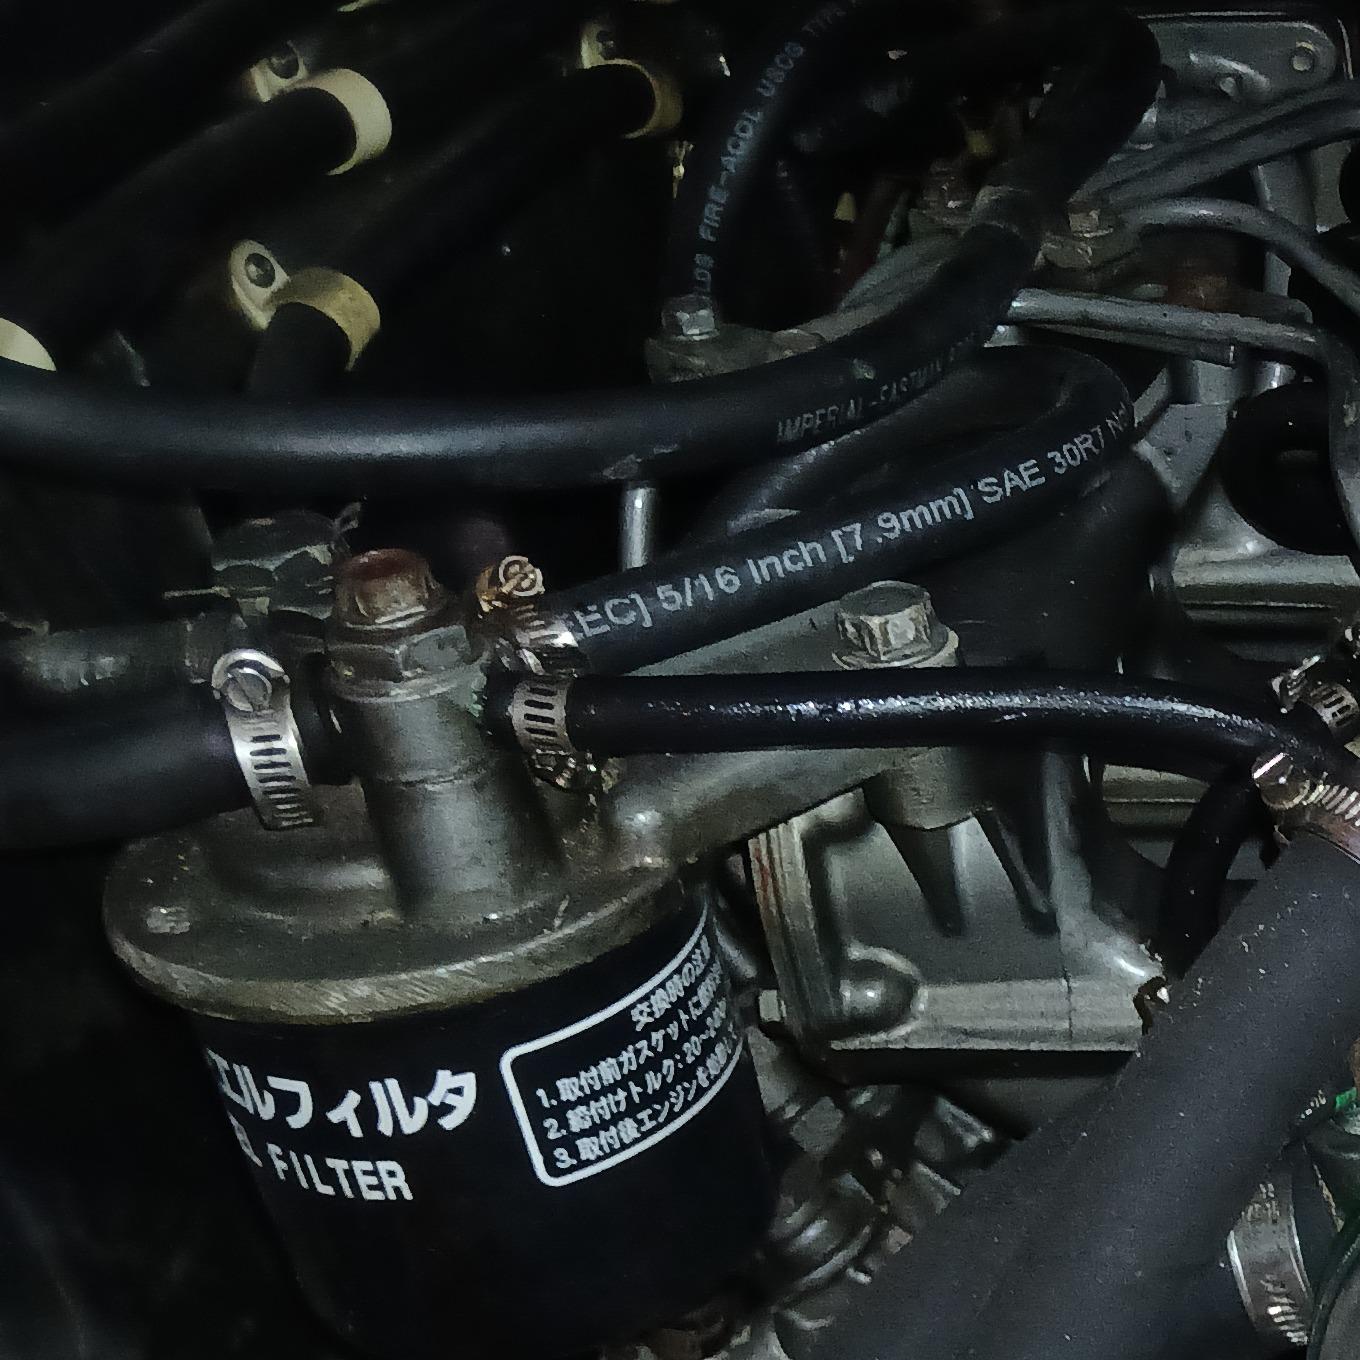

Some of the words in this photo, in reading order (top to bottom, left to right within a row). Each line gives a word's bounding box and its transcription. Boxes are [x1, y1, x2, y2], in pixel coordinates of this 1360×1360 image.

[659, 566, 741, 612] 5/16
[978, 459, 1046, 503] SAE
[267, 1142, 413, 1200] FILTER
